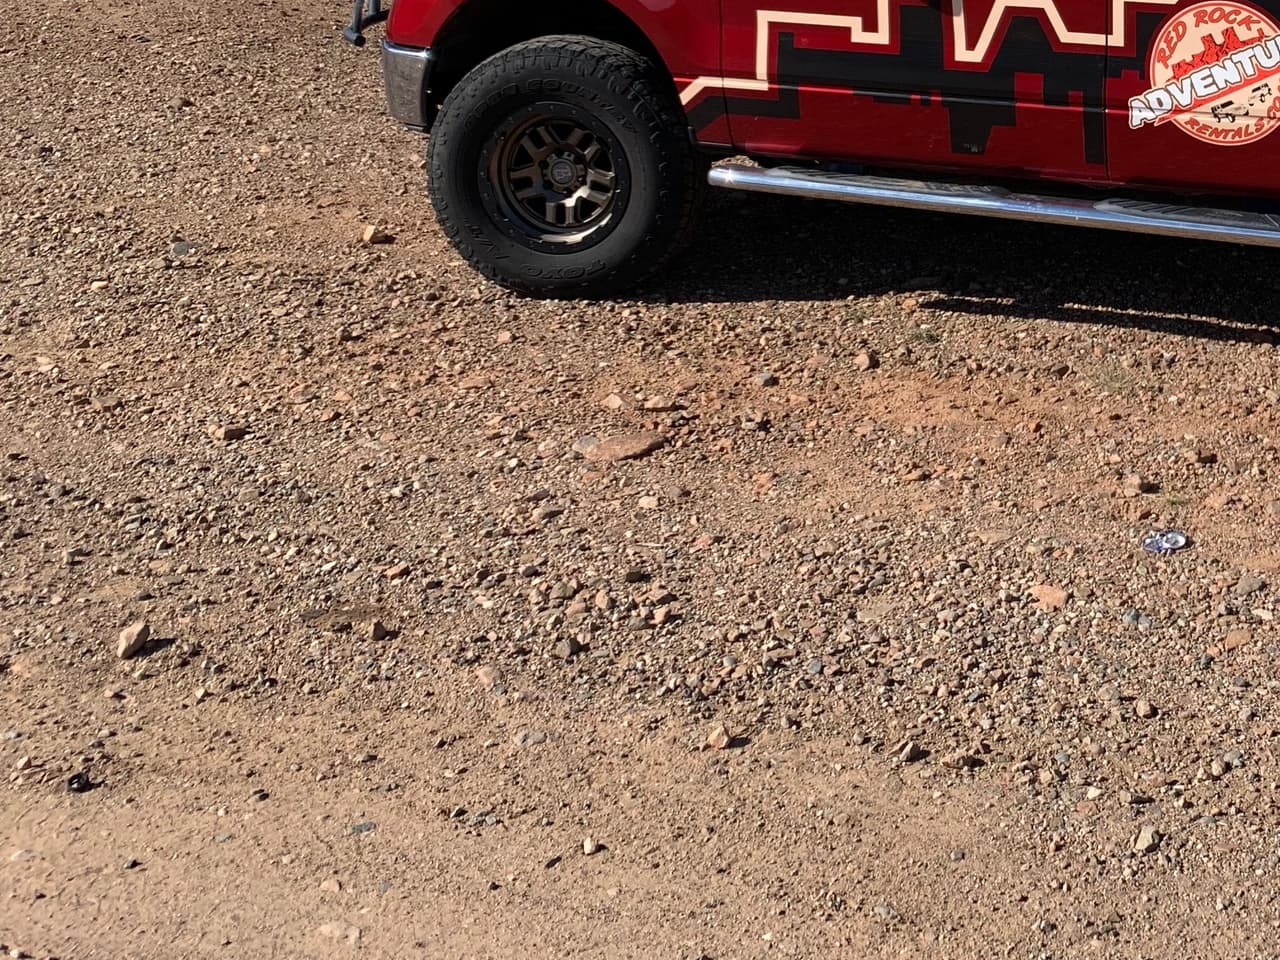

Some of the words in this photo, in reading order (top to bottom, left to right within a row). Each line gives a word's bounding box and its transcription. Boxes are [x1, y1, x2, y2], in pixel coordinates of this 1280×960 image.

[1156, 20, 1188, 69] RED
[1193, 7, 1262, 32] ROCK
[519, 261, 607, 280] TOYO
